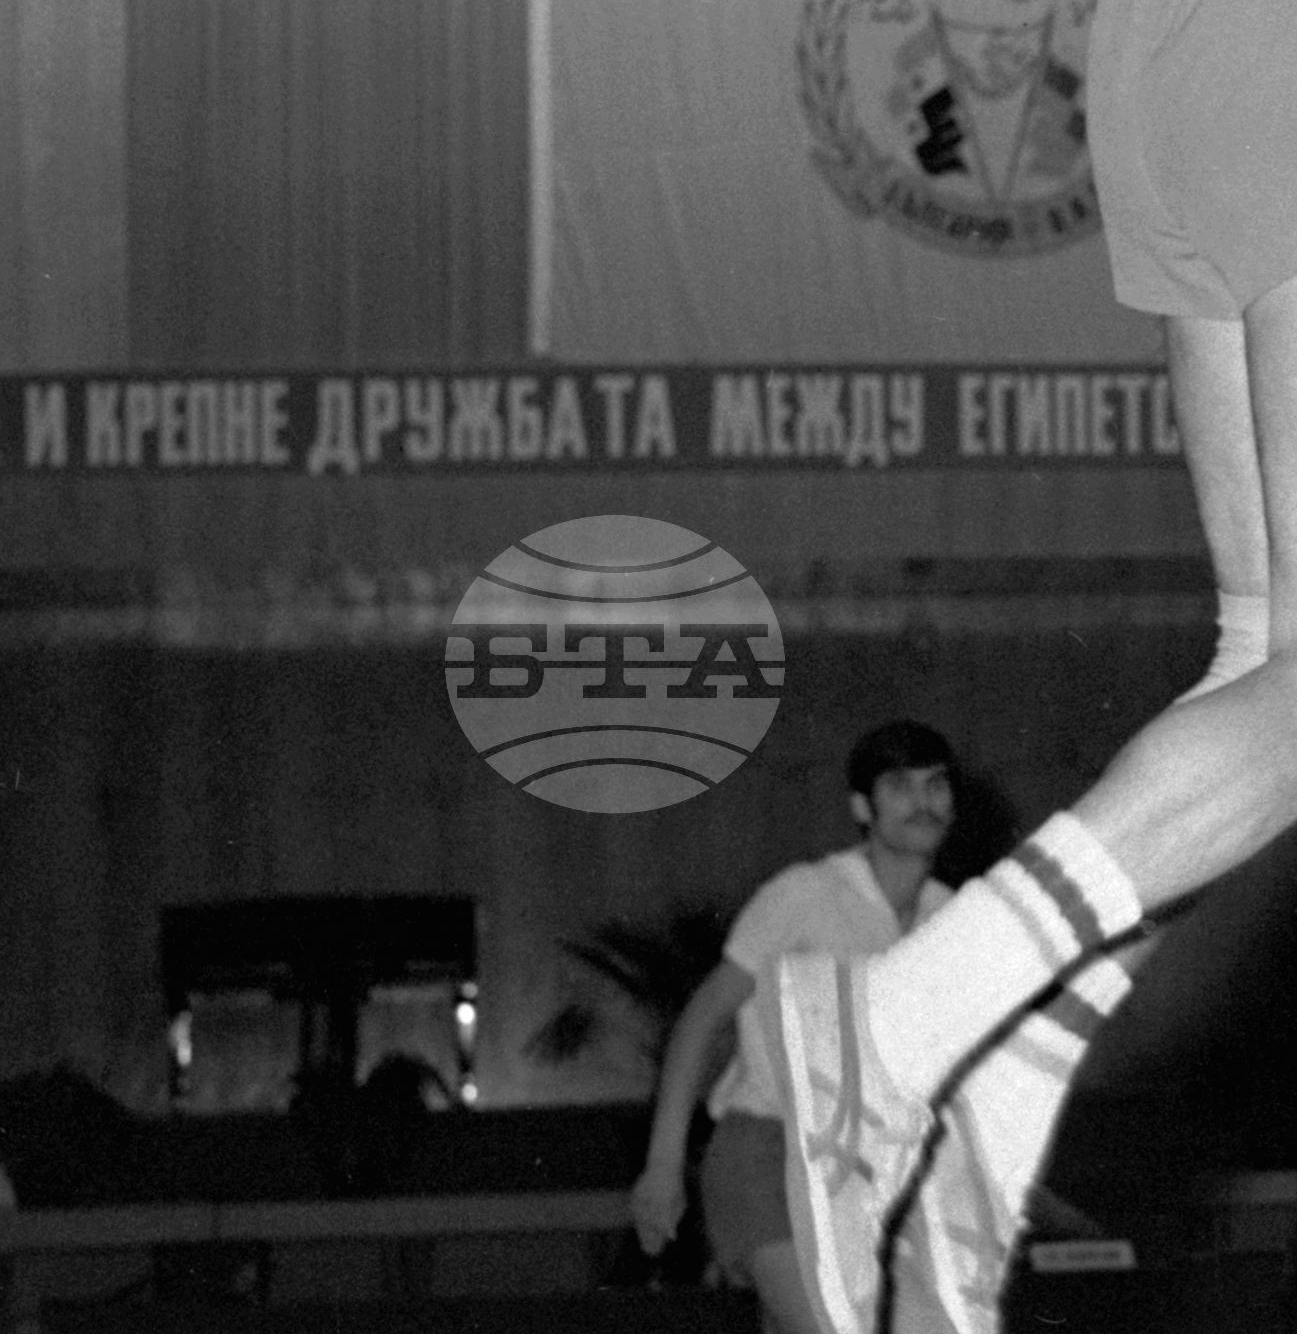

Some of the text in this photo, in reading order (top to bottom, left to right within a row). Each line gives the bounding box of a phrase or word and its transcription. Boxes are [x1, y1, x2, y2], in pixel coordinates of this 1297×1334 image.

[24, 381, 68, 466] И
[307, 373, 676, 476] ДРУЖБАТА
[709, 372, 925, 469] МЕЖДУ
[957, 371, 1180, 458] ЕГИПЕТС
